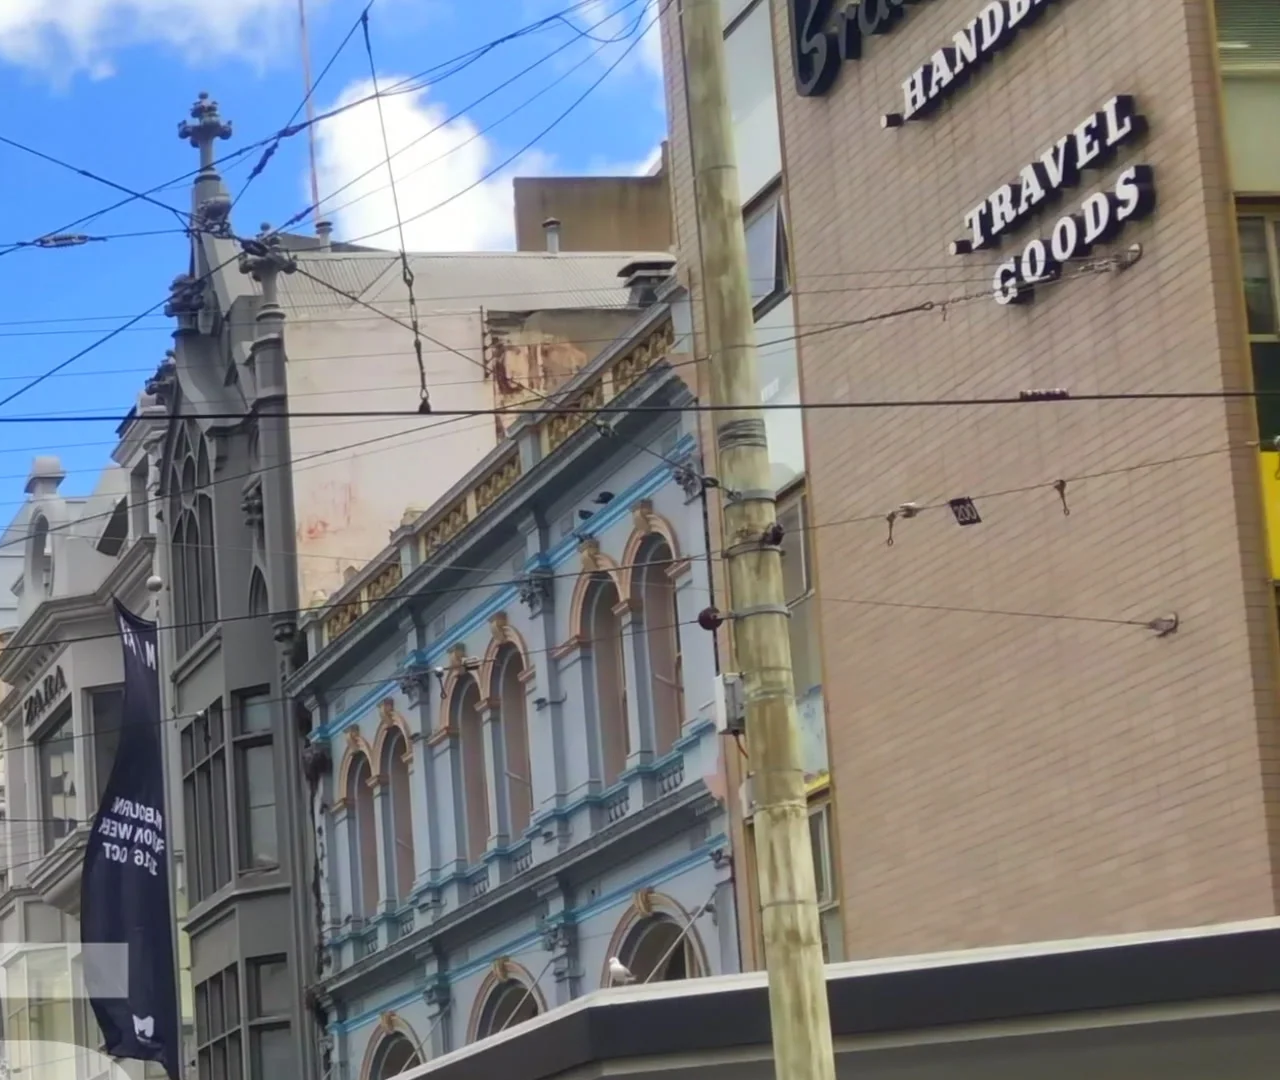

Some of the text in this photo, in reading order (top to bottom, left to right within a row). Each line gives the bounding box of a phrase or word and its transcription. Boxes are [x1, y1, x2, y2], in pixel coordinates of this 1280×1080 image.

[901, 0, 1041, 120] HANDB
[964, 95, 1133, 250] TRAVEL
[992, 166, 1140, 305] GOODS
[24, 665, 68, 727] ZARA
